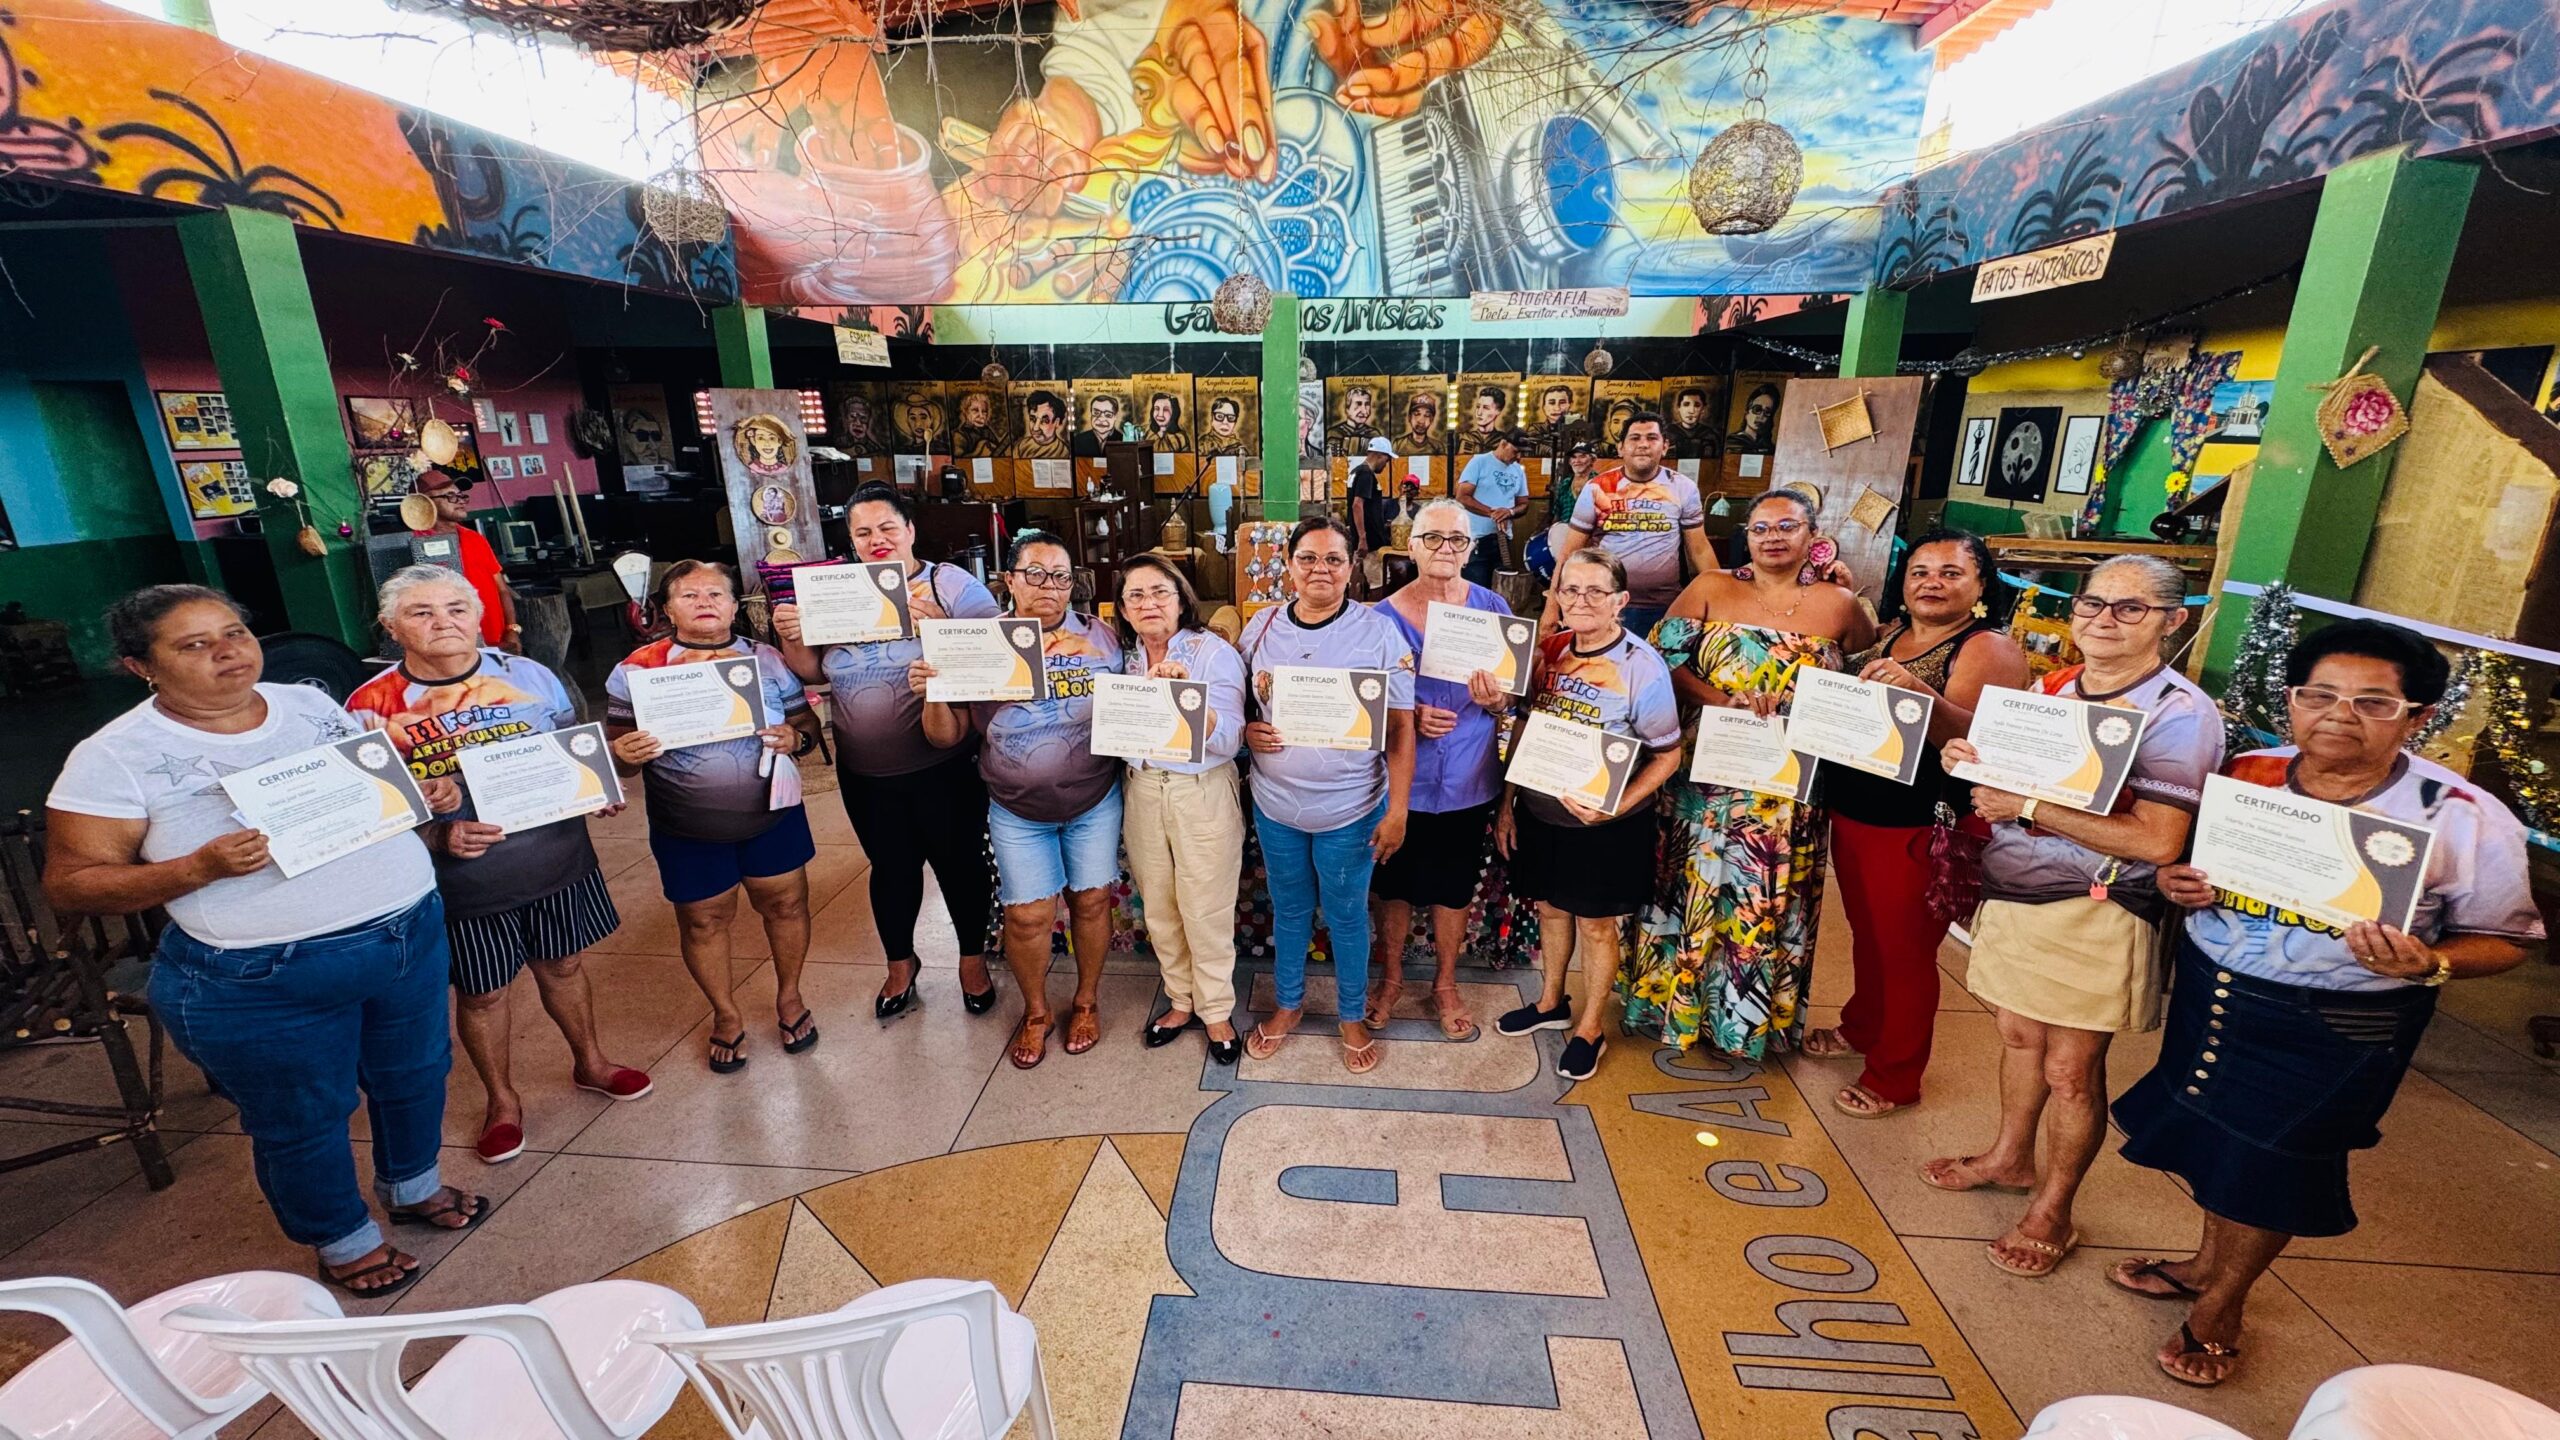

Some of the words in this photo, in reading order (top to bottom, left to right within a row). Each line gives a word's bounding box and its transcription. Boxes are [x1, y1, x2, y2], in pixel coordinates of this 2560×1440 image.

[1978, 266, 2018, 296] FATOS
[2022, 246, 2105, 288] HISTÓRICOS
[1508, 291, 1588, 306] BIOGRAFIA
[1332, 299, 1448, 335] Artistas
[1626, 498, 1662, 511] Feira
[1633, 511, 1667, 520] CULTURA
[1602, 520, 1637, 532] Dona
[810, 573, 856, 582] CERTIFICADO
[1443, 611, 1487, 625] CERTIFICADO
[938, 628, 988, 636] CERTIFICADO
[650, 672, 703, 685] CERTIFICADO
[1291, 675, 1338, 684] CERTIFICADO
[1555, 673, 1600, 701] Feira
[1817, 678, 1871, 697] CERTIFICADO
[1111, 683, 1158, 693] CERTIFICADO
[1556, 697, 1601, 718] CULTURA
[2003, 699, 2067, 717] CERTIFICADO
[405, 718, 442, 745] II
[438, 705, 511, 734] Feira
[1544, 722, 1588, 740] CERTIFICADO
[1719, 716, 1769, 728] CERTIFICADO
[412, 738, 454, 760] ARTE
[452, 735, 465, 749] E
[464, 721, 532, 745] CULTURA
[483, 744, 543, 763] CERTIFICADO
[258, 759, 327, 787] CERTIFICADO
[408, 755, 460, 780] Don
[2235, 794, 2322, 824] CERTIFICADO
[1705, 1160, 1828, 1209] e
